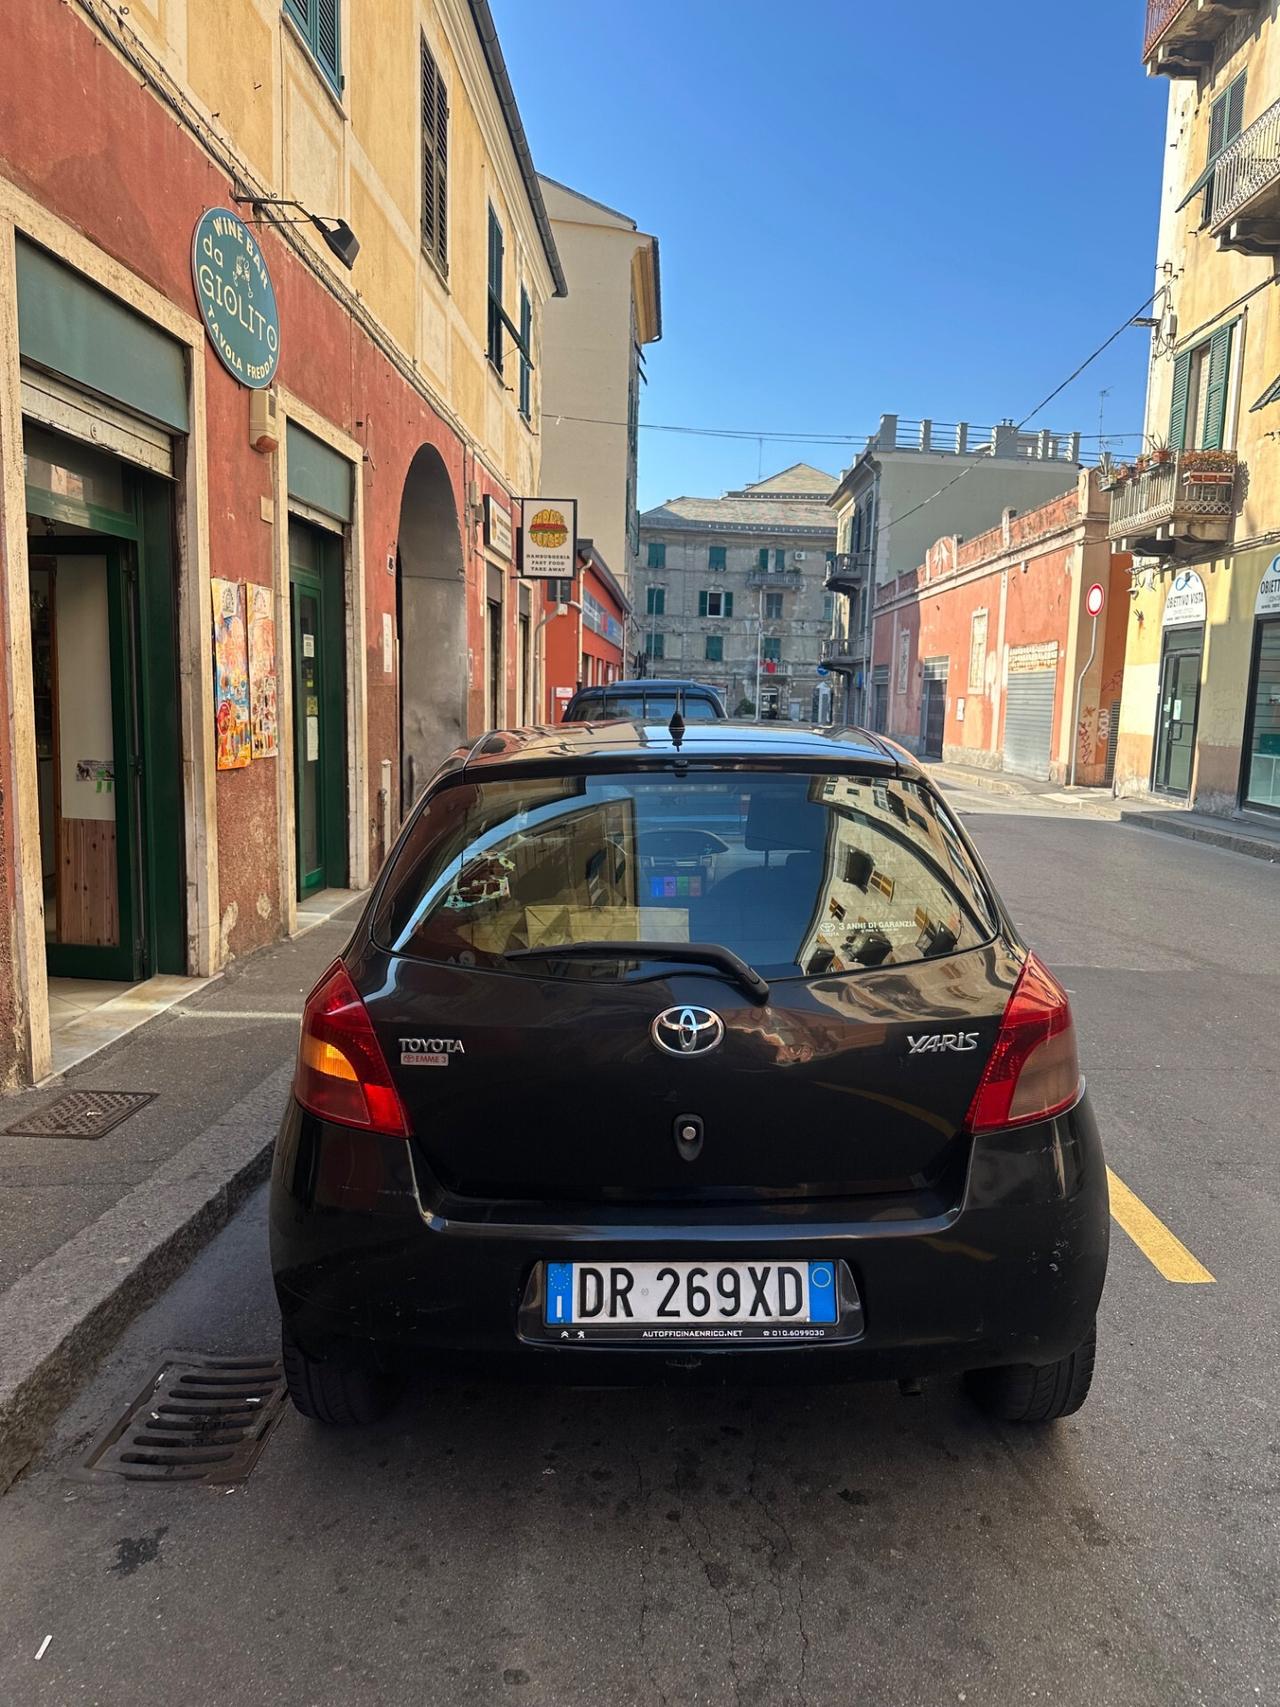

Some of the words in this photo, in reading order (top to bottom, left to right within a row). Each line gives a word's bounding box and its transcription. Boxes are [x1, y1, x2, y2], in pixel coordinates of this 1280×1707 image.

[203, 233, 223, 268] da
[213, 216, 243, 244] WINE
[246, 236, 267, 290] BAR
[200, 264, 278, 352] GIOLITO
[207, 304, 243, 372] TAVOLA
[247, 354, 274, 379] FREDDA
[839, 922, 845, 930] 3
[846, 922, 867, 930] ANNI
[868, 921, 877, 929] DI
[878, 920, 917, 928] GARANZIA
[398, 1038, 465, 1053] TOYOTA
[415, 1055, 440, 1063] EMME
[578, 1267, 634, 1318] DR
[656, 1266, 804, 1318] 269XD
[642, 1330, 743, 1338] AUTOFFICINAENRICO.NET
